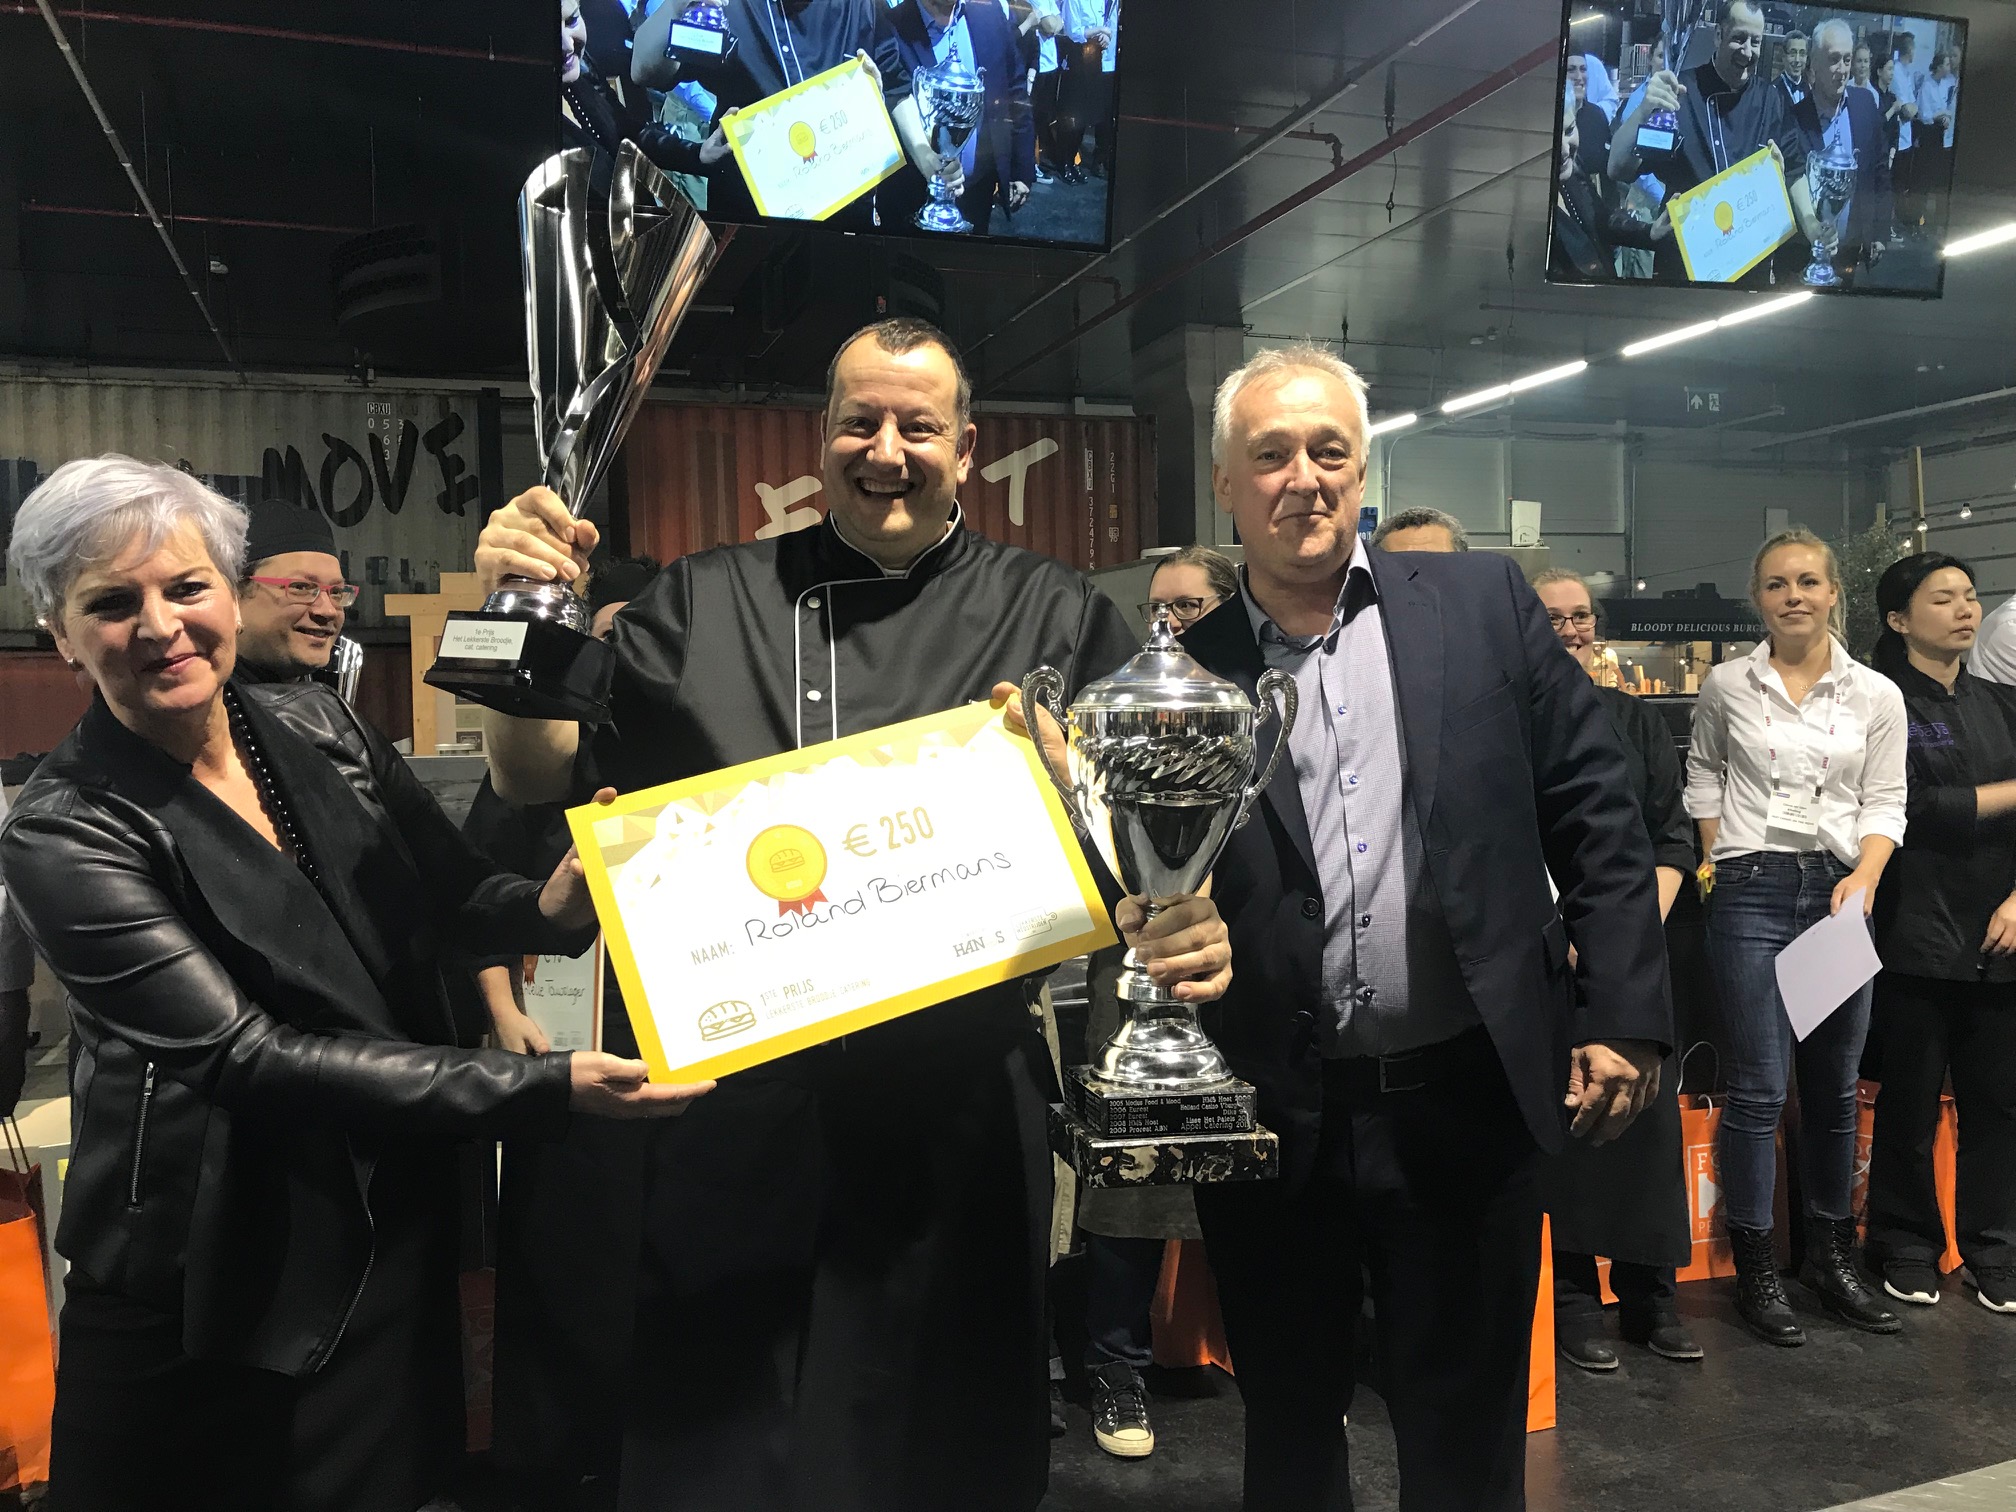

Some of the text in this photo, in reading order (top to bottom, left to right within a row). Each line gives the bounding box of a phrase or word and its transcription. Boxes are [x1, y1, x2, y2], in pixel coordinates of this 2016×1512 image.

[261, 412, 479, 528] MOVE
[482, 628, 494, 637] Prijs
[1630, 623, 1674, 632] BLOODY
[1676, 623, 1731, 632] DELICIOUS
[842, 806, 934, 857] € 250
[744, 852, 1012, 946] Roland Biermans
[690, 940, 735, 966] NAAM:
[782, 978, 814, 1000] PRIJS
